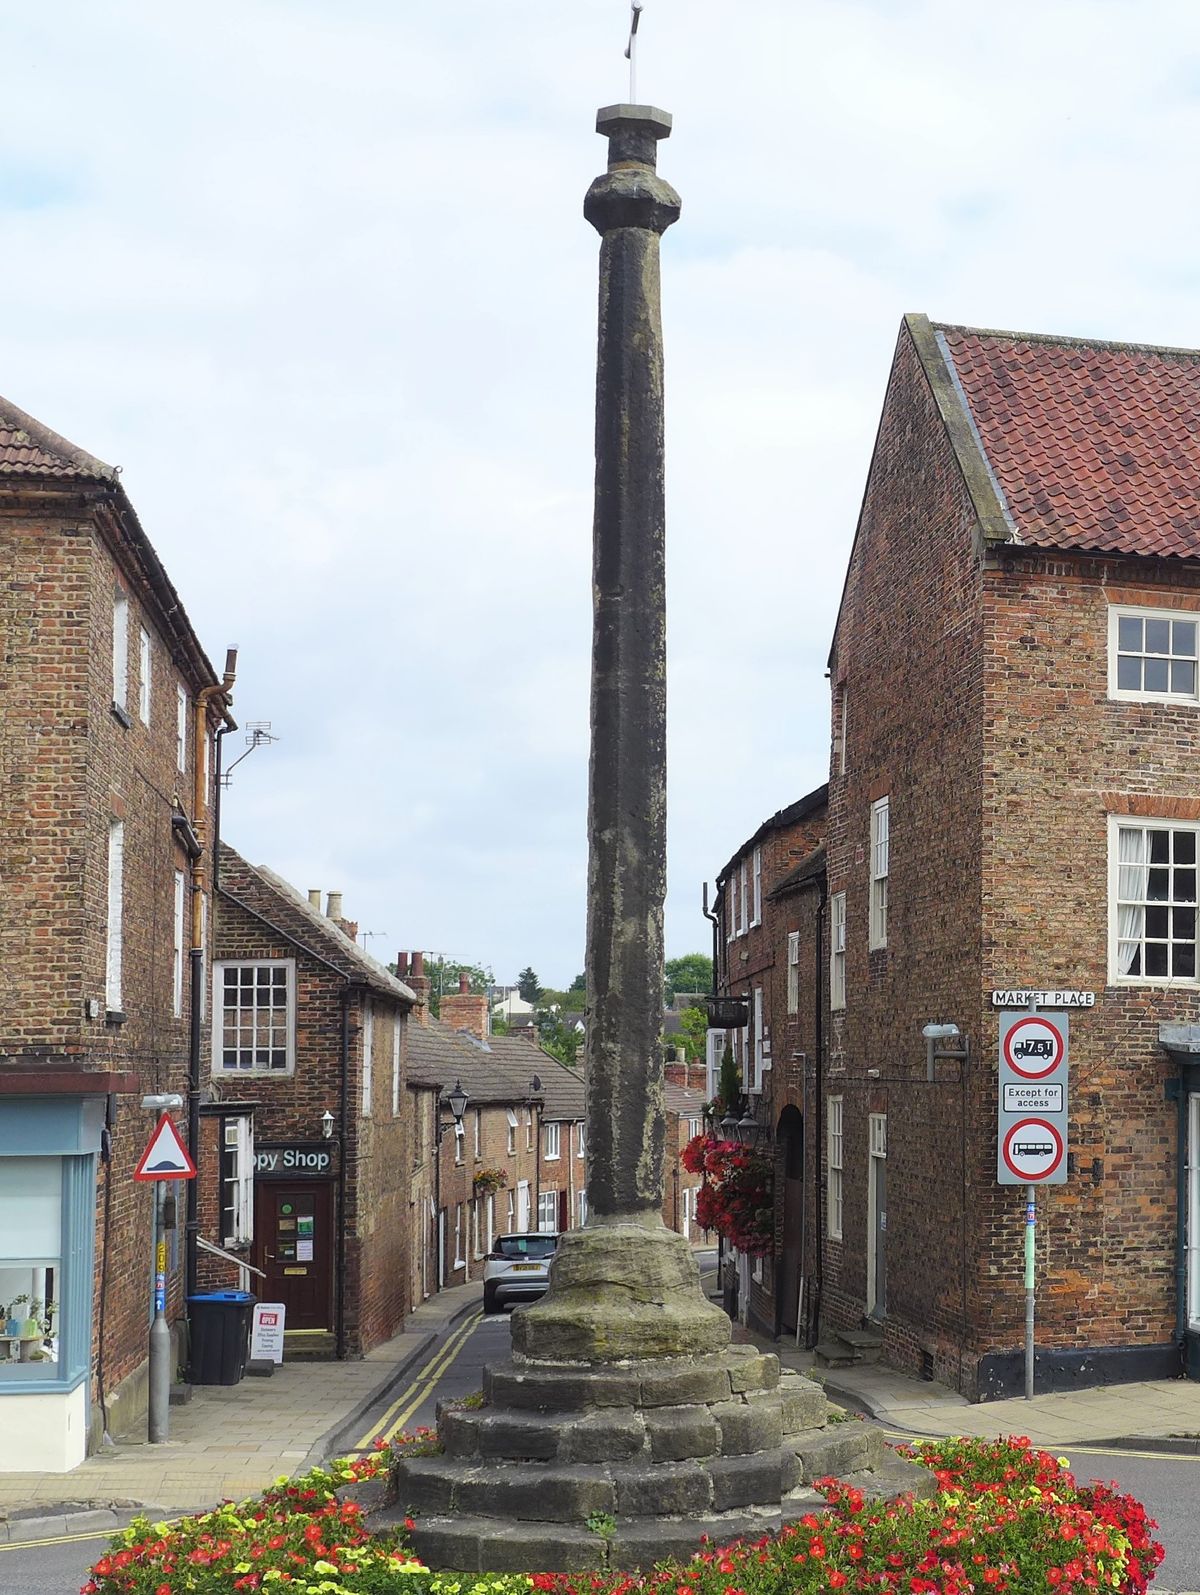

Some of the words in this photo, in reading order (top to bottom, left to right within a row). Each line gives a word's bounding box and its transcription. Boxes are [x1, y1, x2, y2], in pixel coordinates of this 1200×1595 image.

[995, 992, 1049, 1005] MARKET
[1055, 993, 1092, 1005] PLACE
[1008, 1088, 1042, 1098] Except
[1044, 1088, 1058, 1097] for
[1017, 1099, 1050, 1107] access
[283, 1149, 330, 1171] Shop
